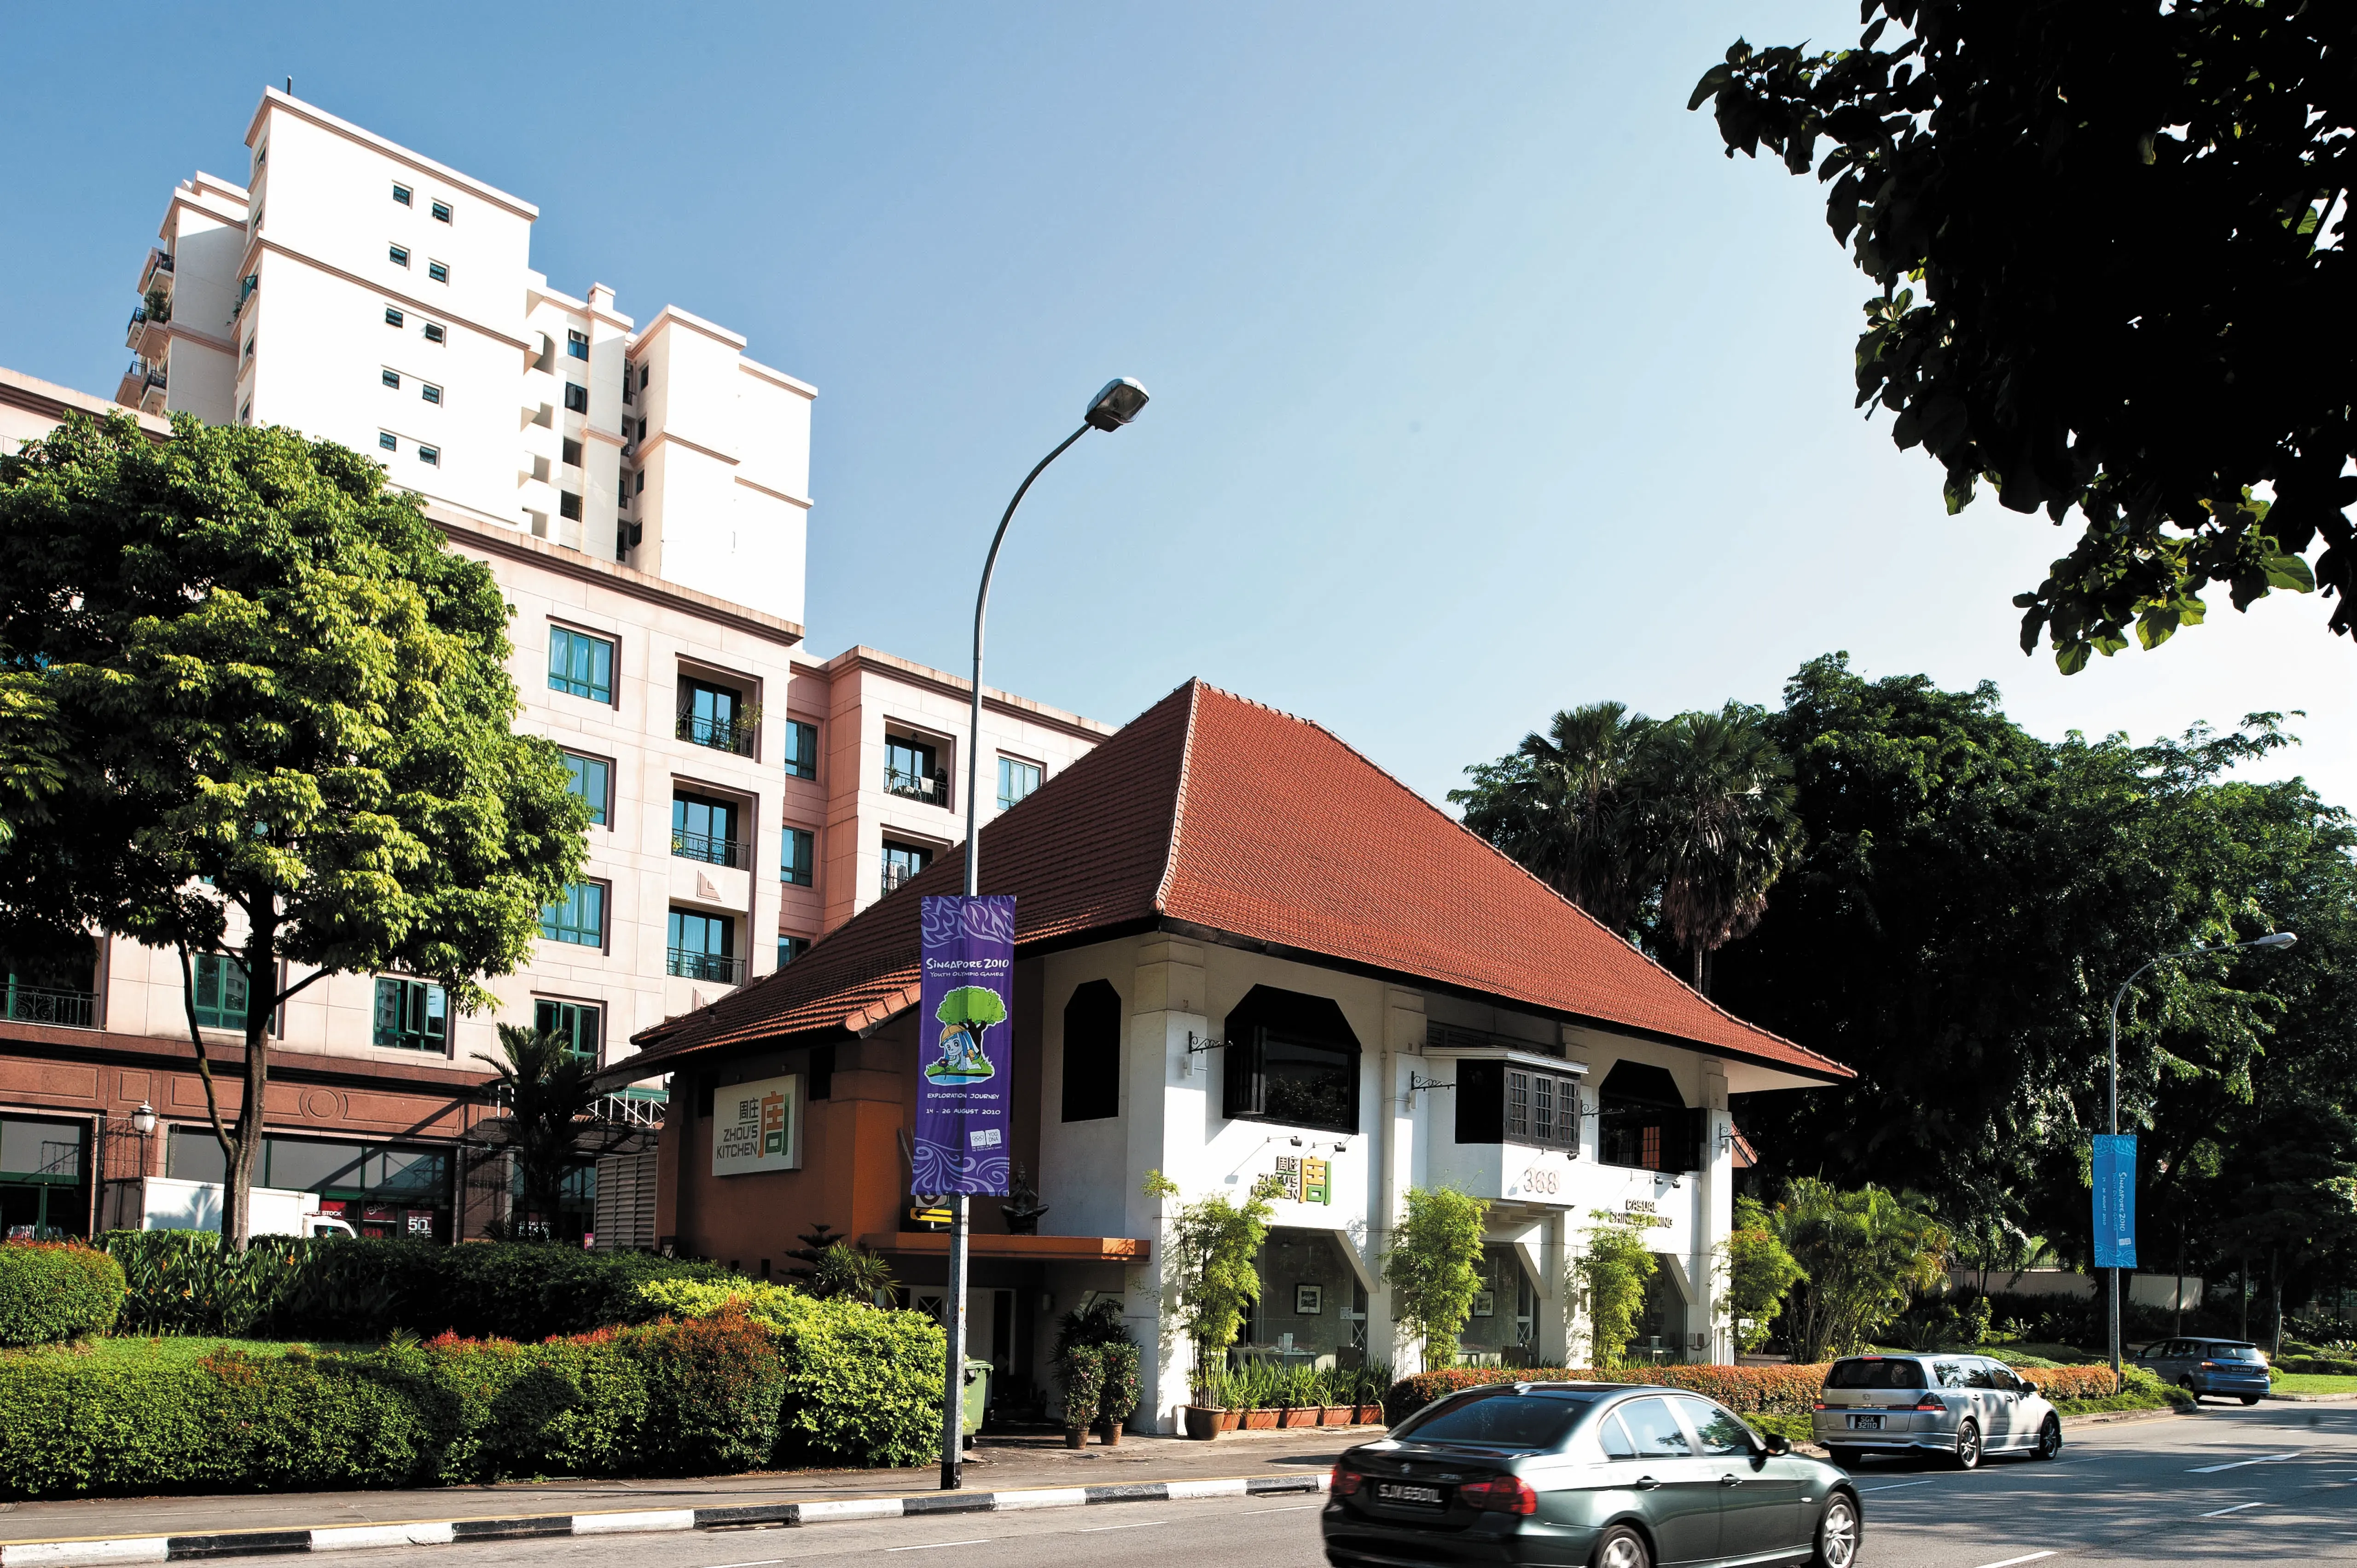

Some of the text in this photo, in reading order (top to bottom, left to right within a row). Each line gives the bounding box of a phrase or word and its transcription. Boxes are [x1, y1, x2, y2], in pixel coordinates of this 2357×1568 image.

[983, 959, 1009, 969] 2010
[723, 1125, 758, 1142] ZHOU'S
[717, 1141, 757, 1159] KITCHEN
[1626, 1198, 1658, 1213] CASUAL
